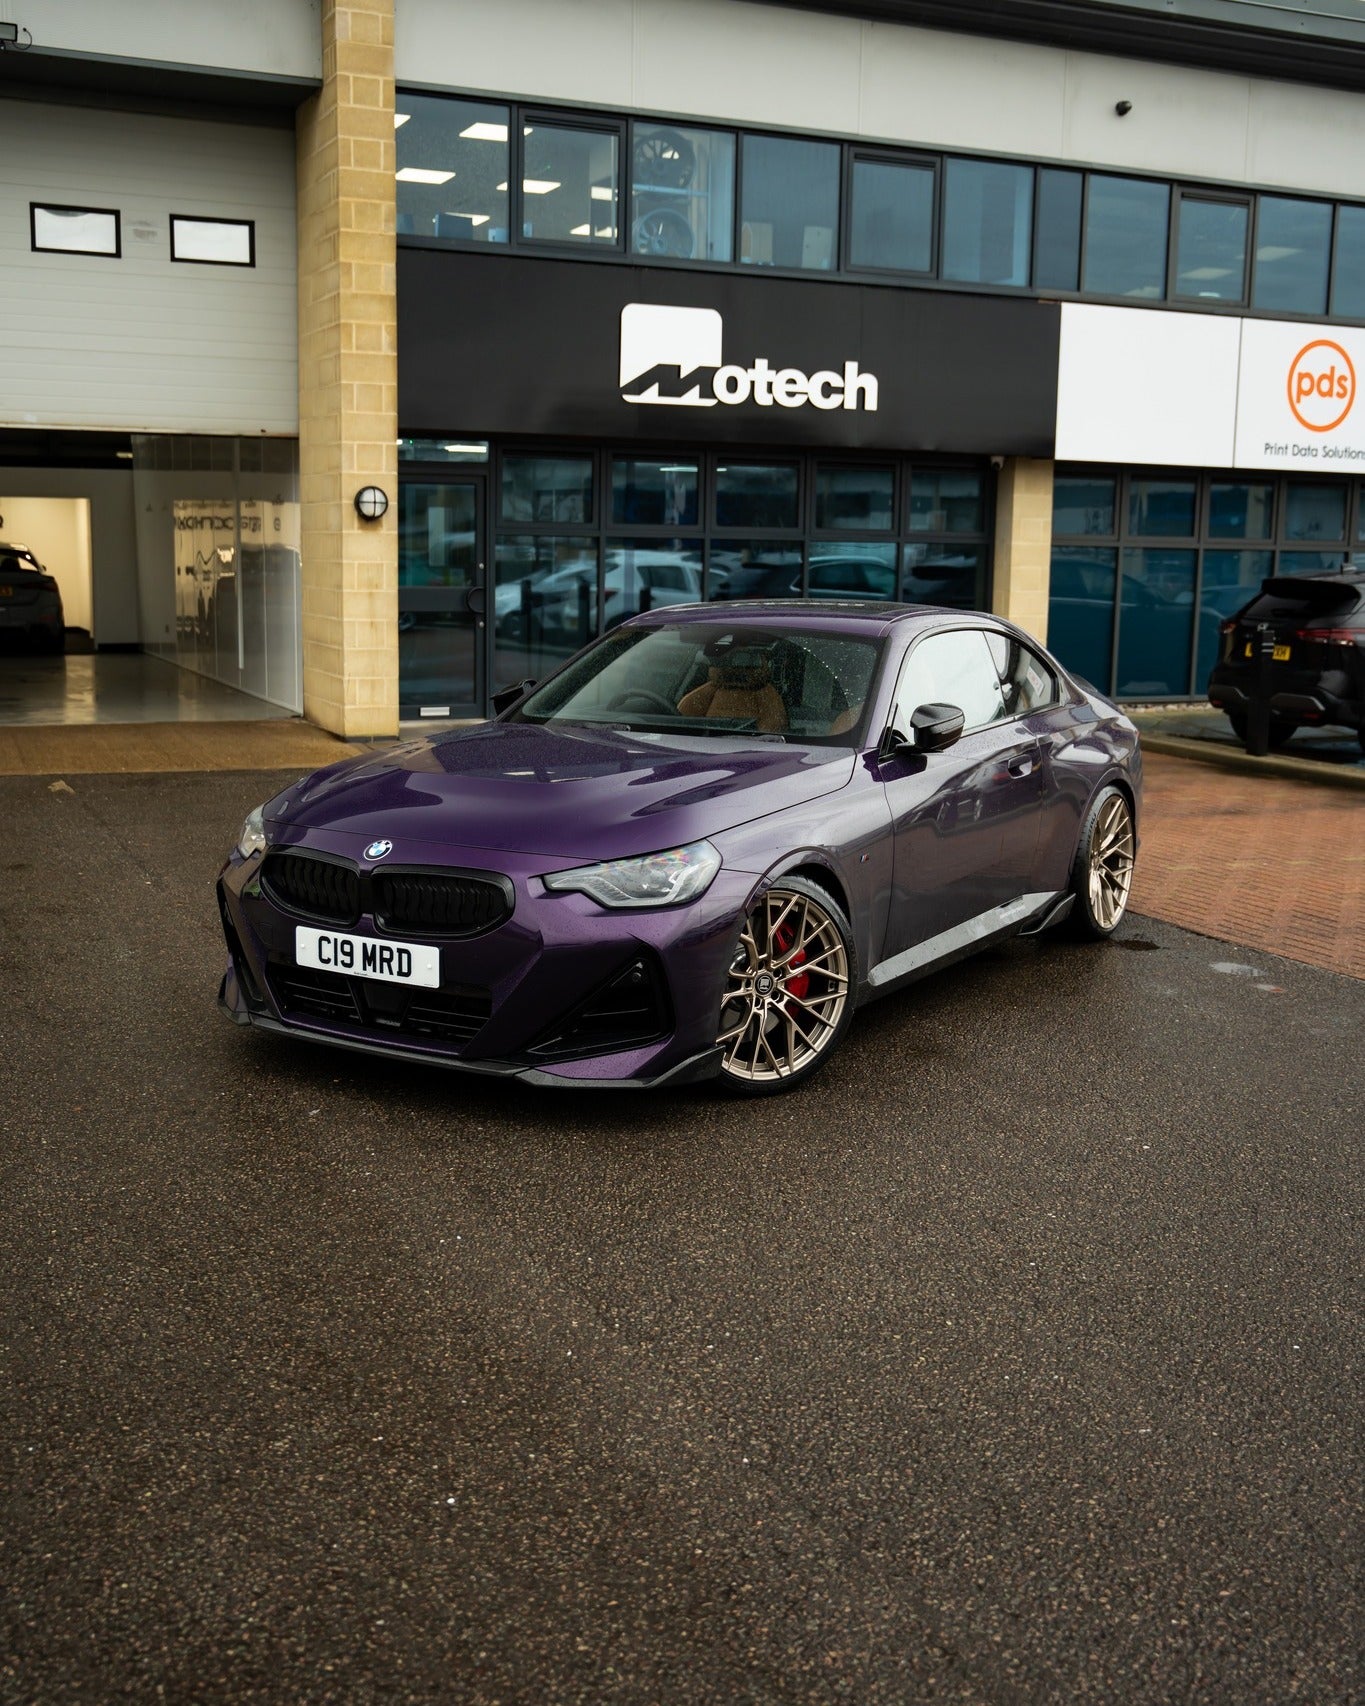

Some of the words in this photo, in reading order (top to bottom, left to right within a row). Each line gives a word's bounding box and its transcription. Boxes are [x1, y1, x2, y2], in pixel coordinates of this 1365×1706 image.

[1296, 365, 1349, 403] pds
[1264, 442, 1288, 456] Print
[1292, 444, 1318, 458] Data
[318, 935, 354, 969] C19
[362, 942, 412, 978] MRD
